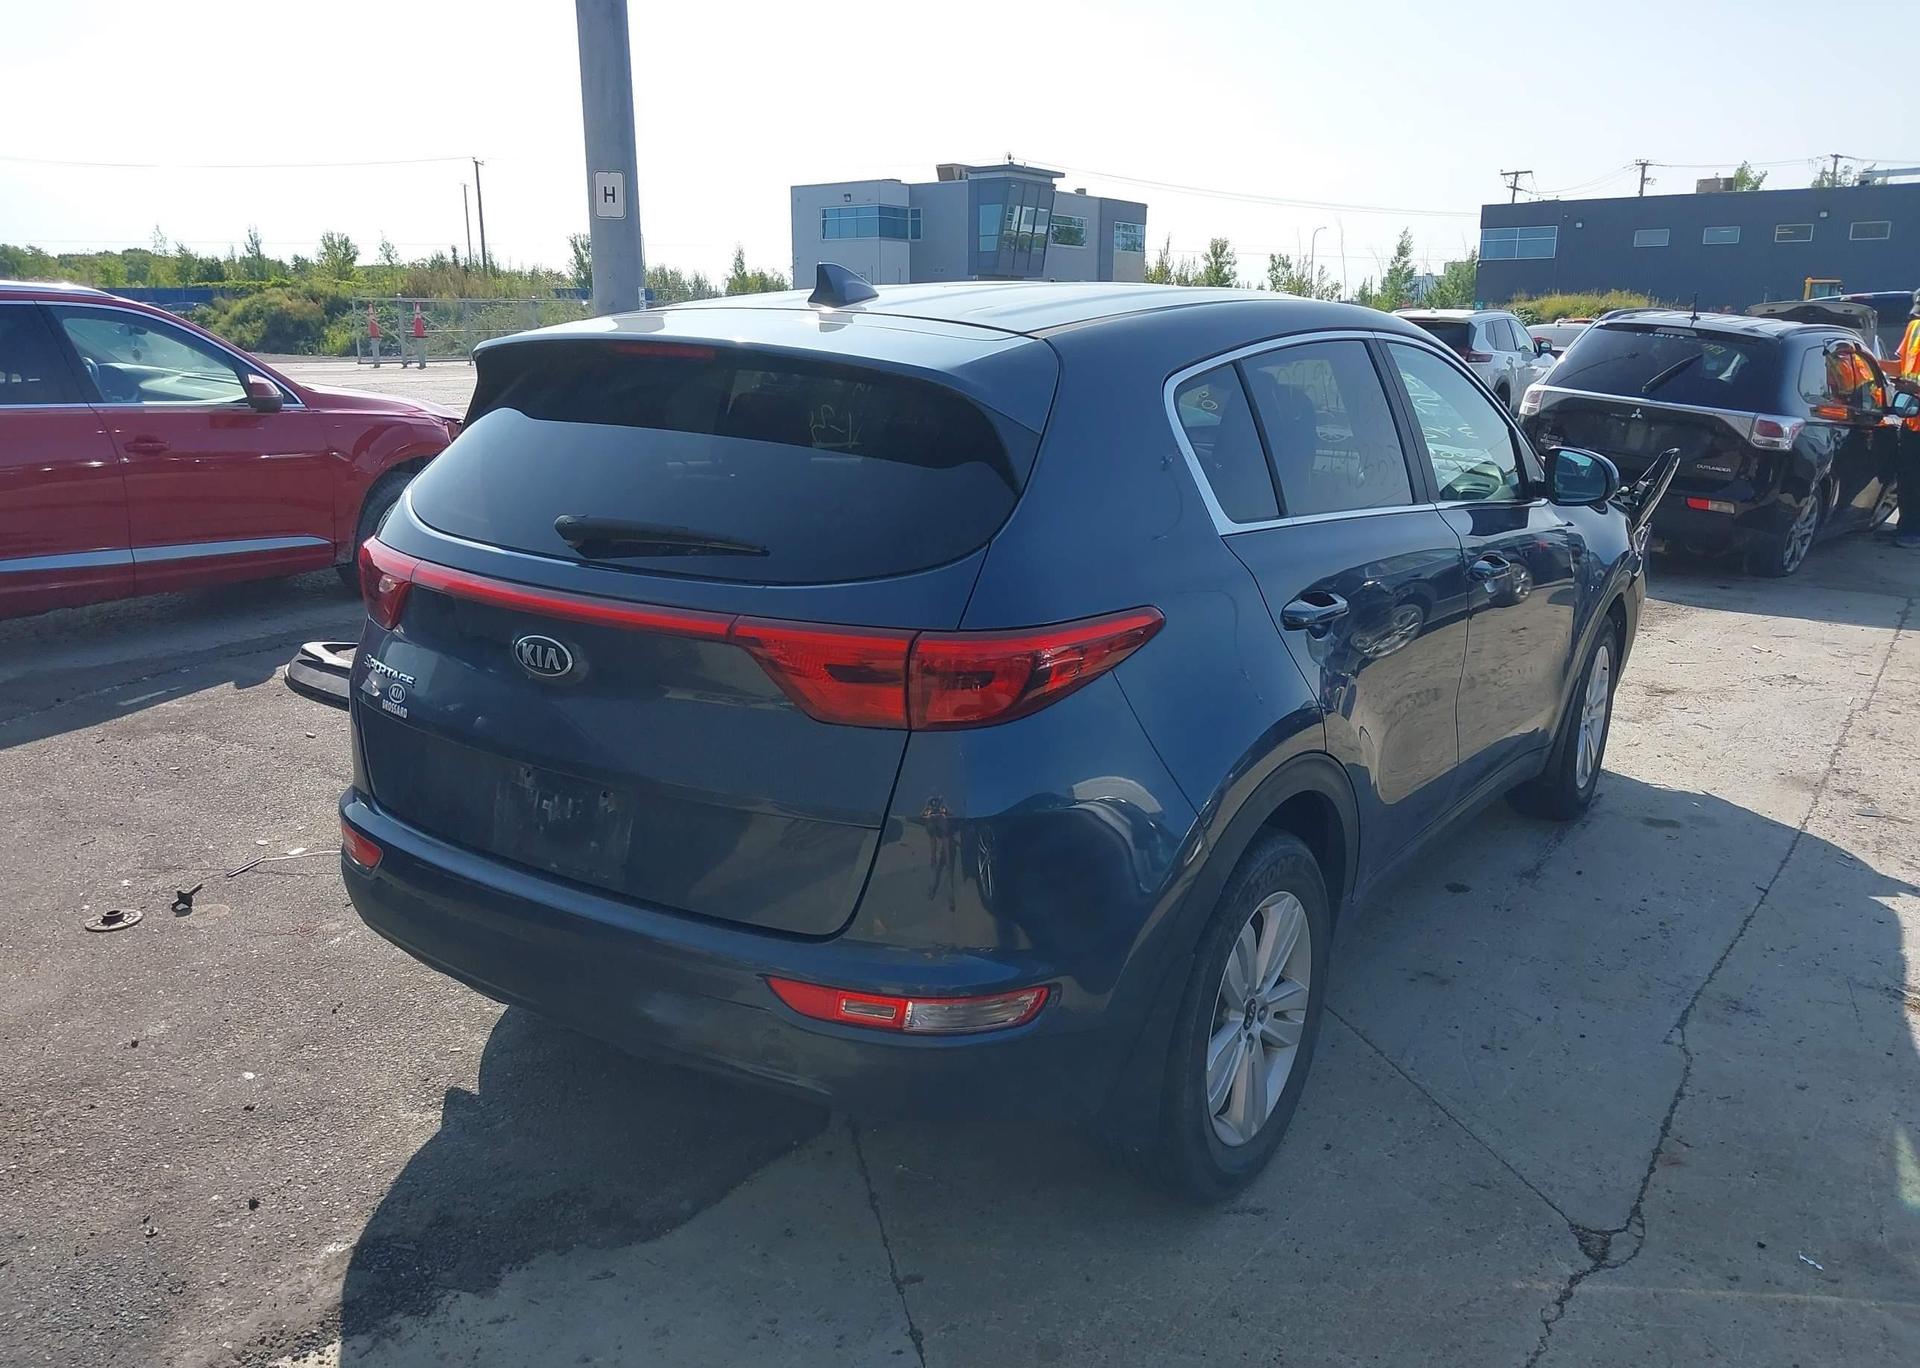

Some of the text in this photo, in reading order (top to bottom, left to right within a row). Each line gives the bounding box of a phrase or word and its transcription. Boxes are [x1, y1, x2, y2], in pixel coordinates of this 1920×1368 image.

[603, 186, 616, 203] H
[1696, 463, 1732, 473] OUTLANDER
[521, 641, 562, 671] KIA
[364, 653, 415, 685] SPORTAGE
